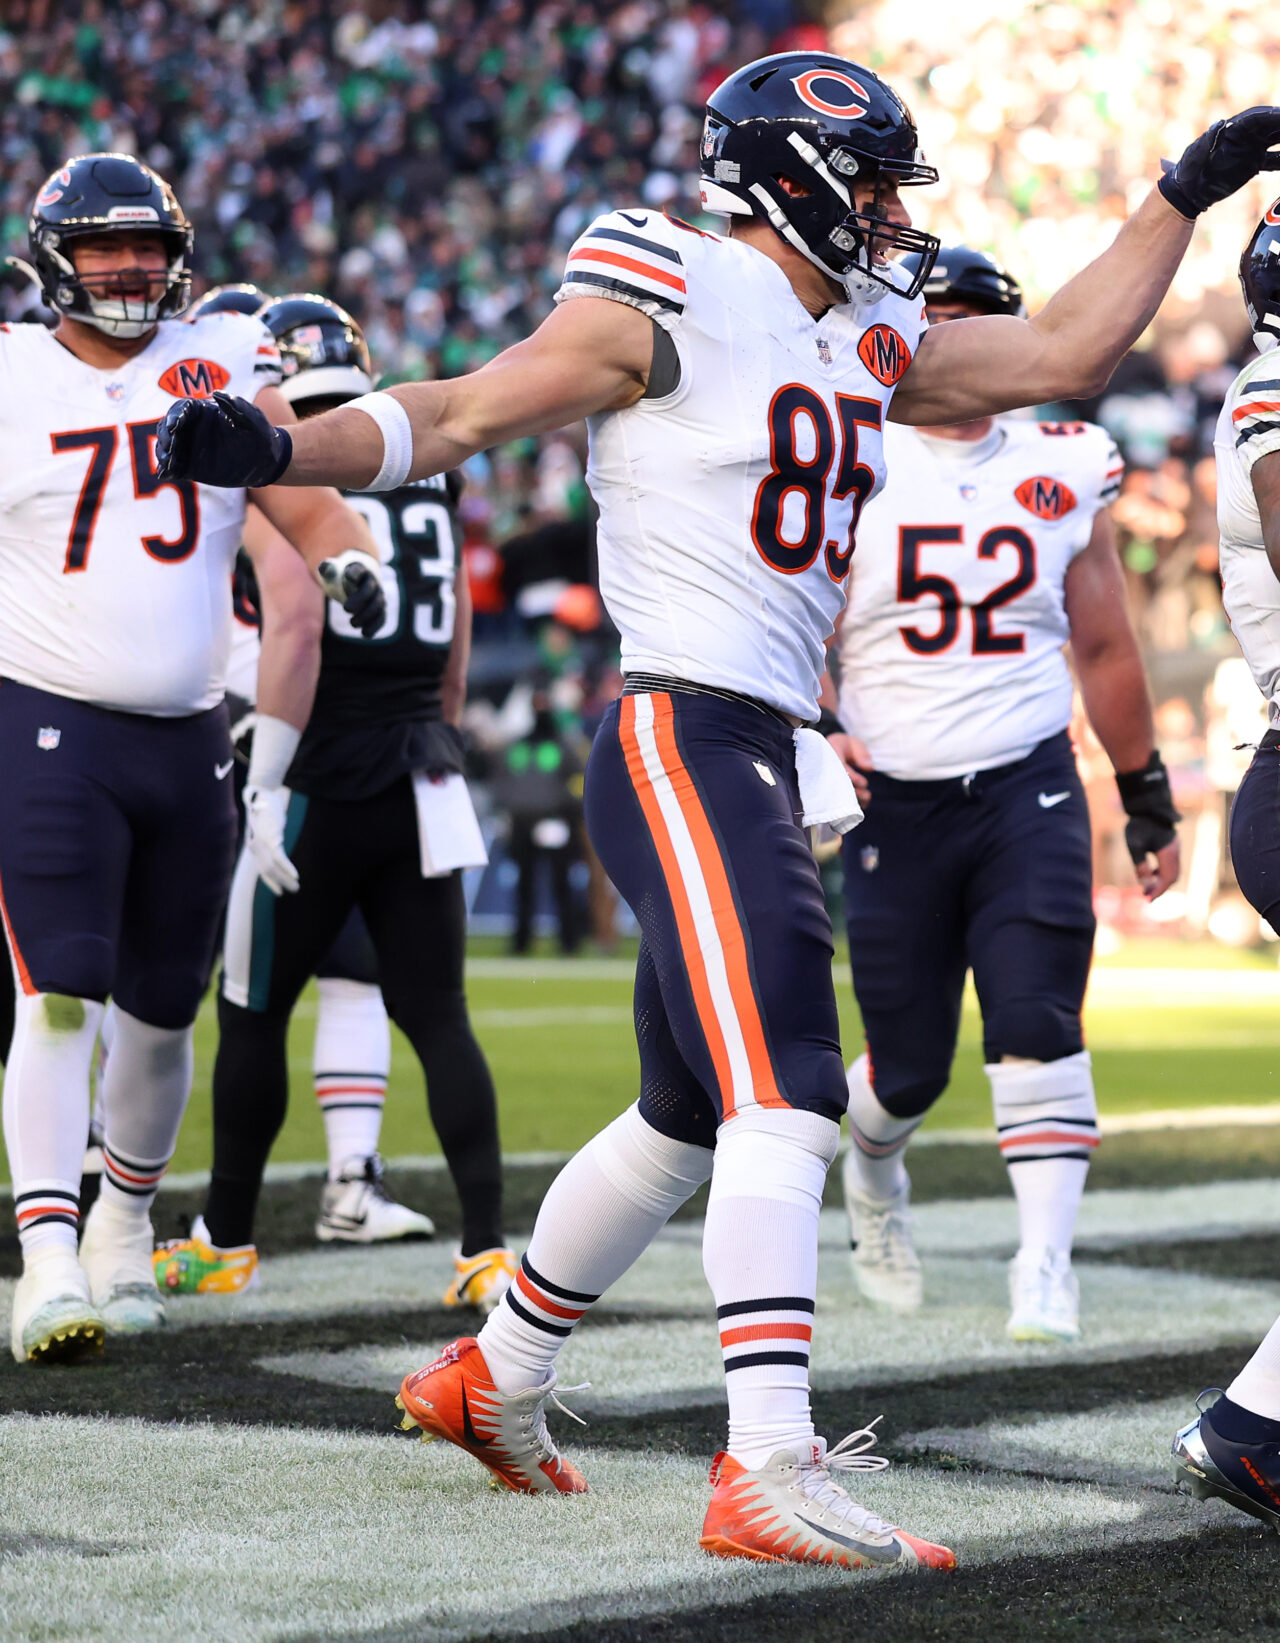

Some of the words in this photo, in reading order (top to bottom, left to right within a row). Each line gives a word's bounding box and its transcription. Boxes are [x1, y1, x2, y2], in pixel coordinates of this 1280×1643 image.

[789, 69, 871, 120] C
[50, 416, 200, 574] 75
[751, 382, 882, 584] 85
[897, 524, 1037, 656] 52
